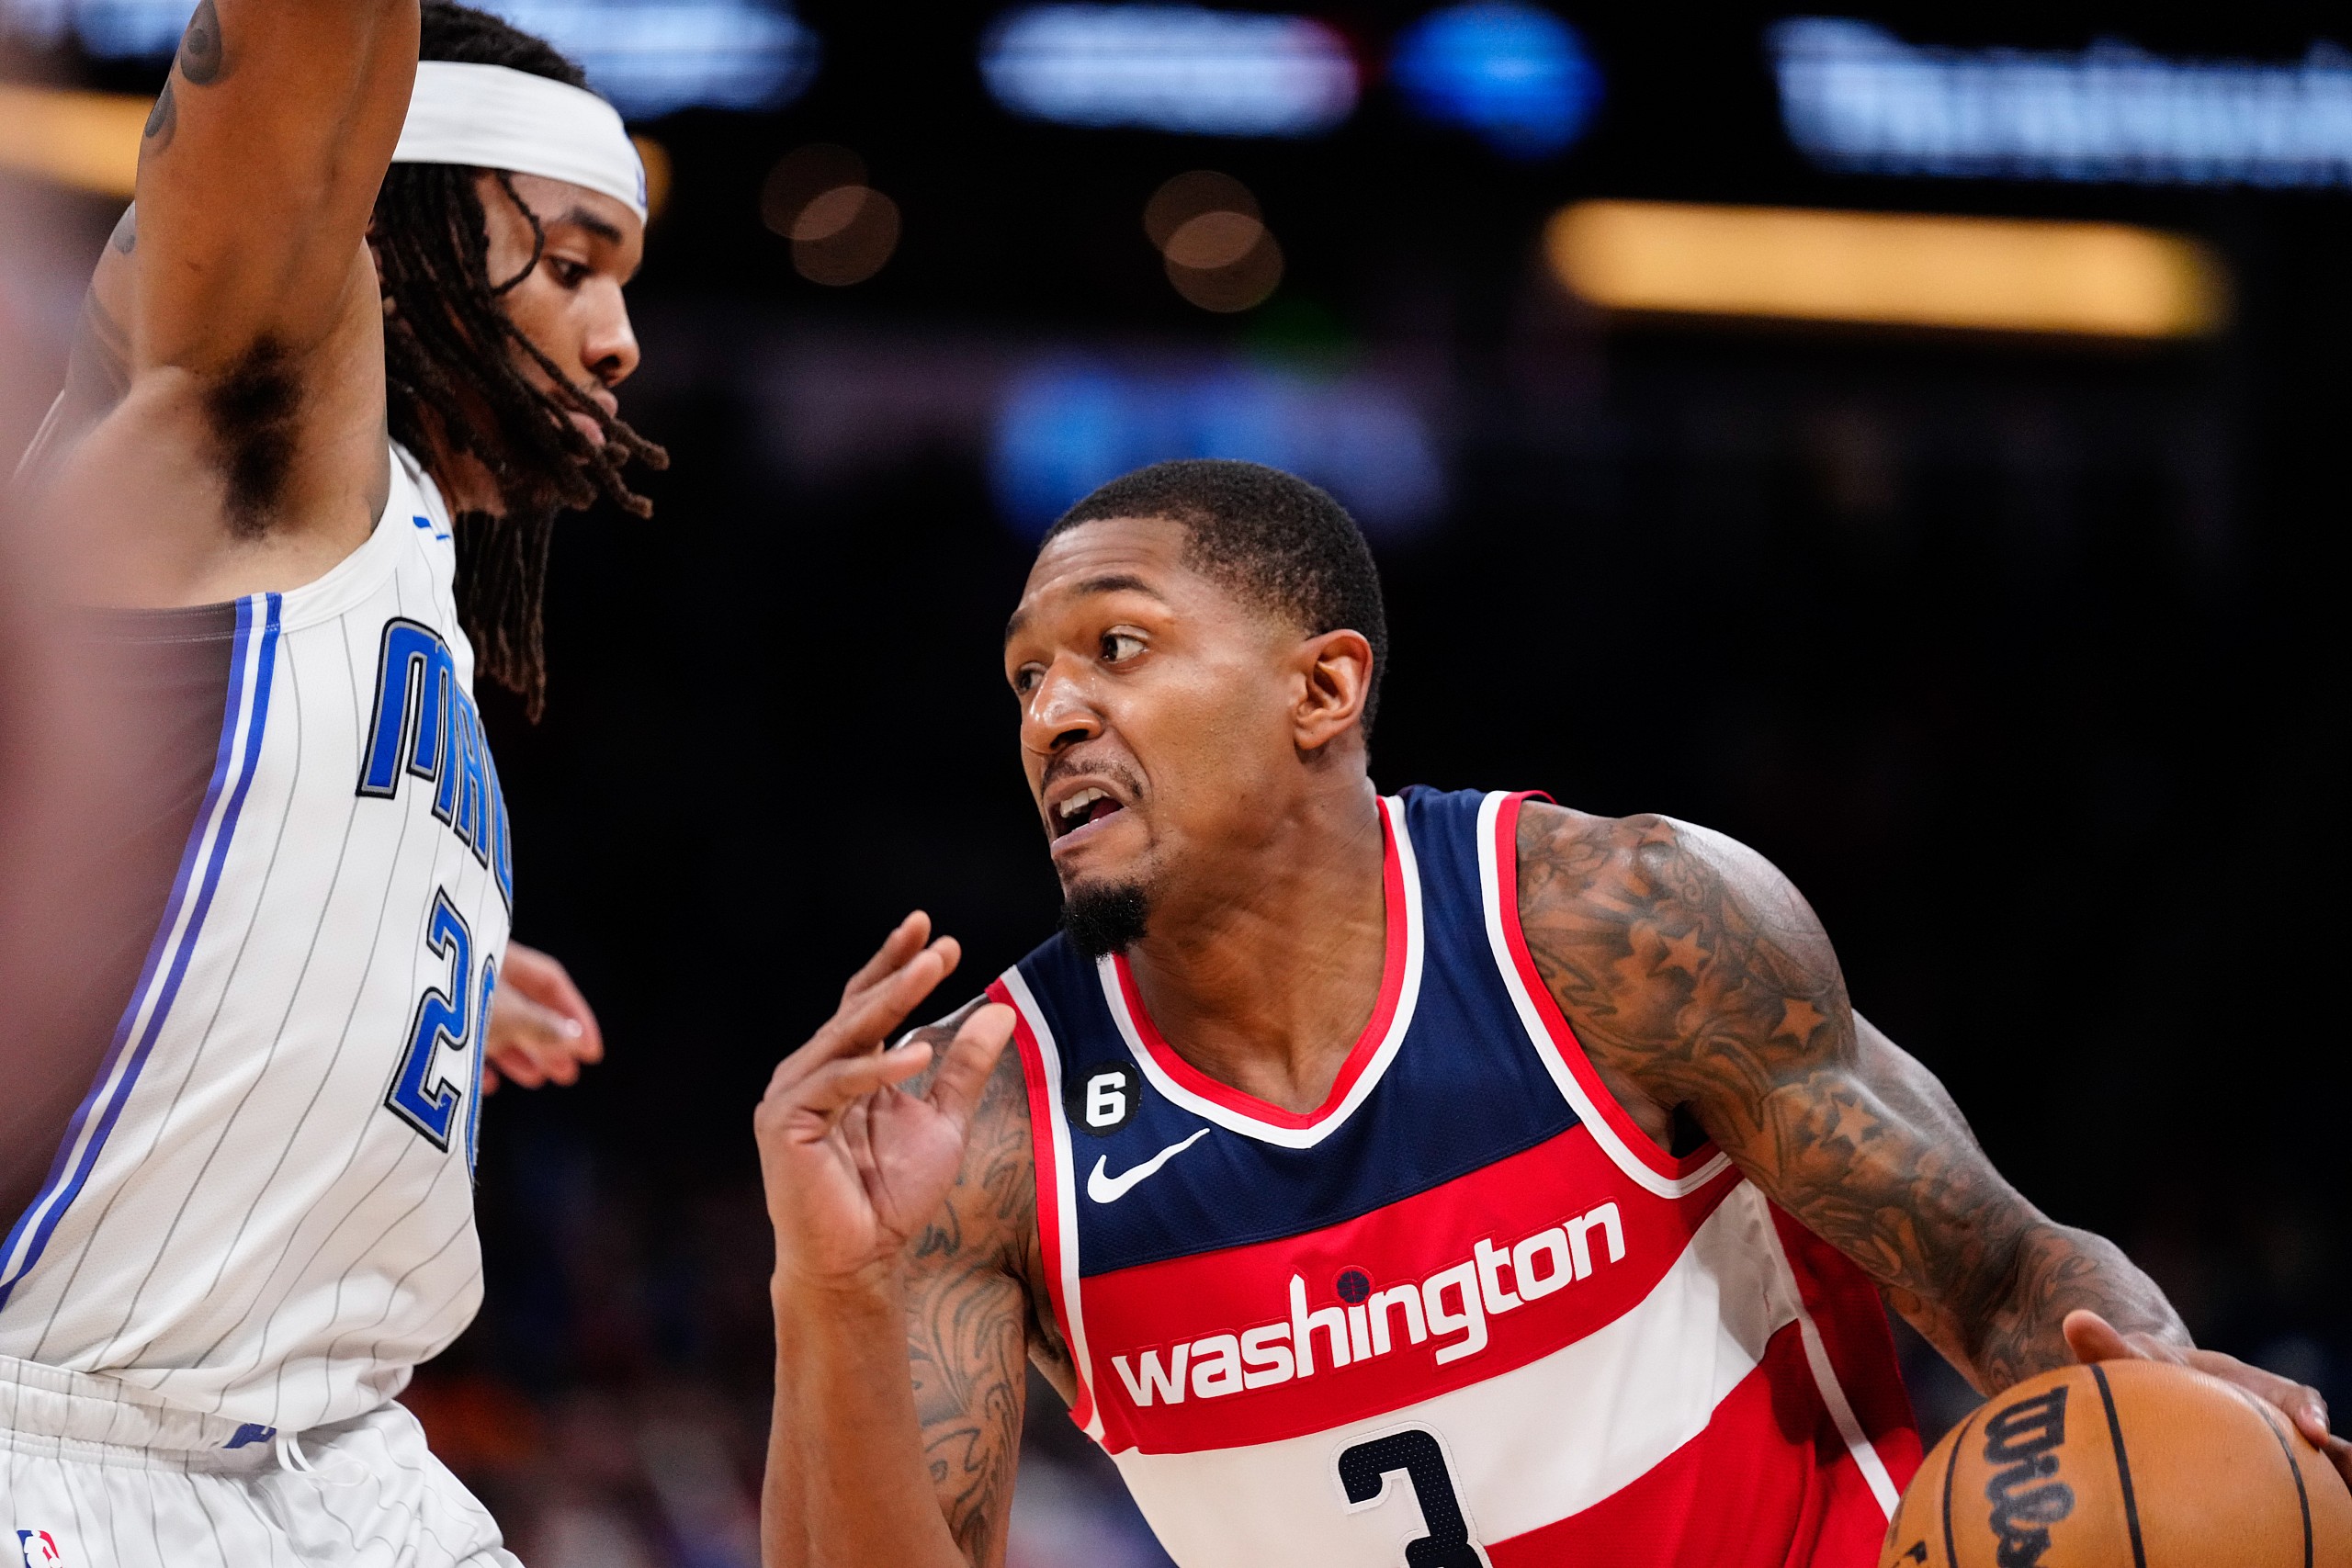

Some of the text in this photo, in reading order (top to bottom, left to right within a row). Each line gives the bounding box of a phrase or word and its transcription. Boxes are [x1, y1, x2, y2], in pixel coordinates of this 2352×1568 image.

[1086, 1071, 1125, 1127] 6
[1112, 1201, 1625, 1406] washington
[1334, 1426, 1487, 1568] 3
